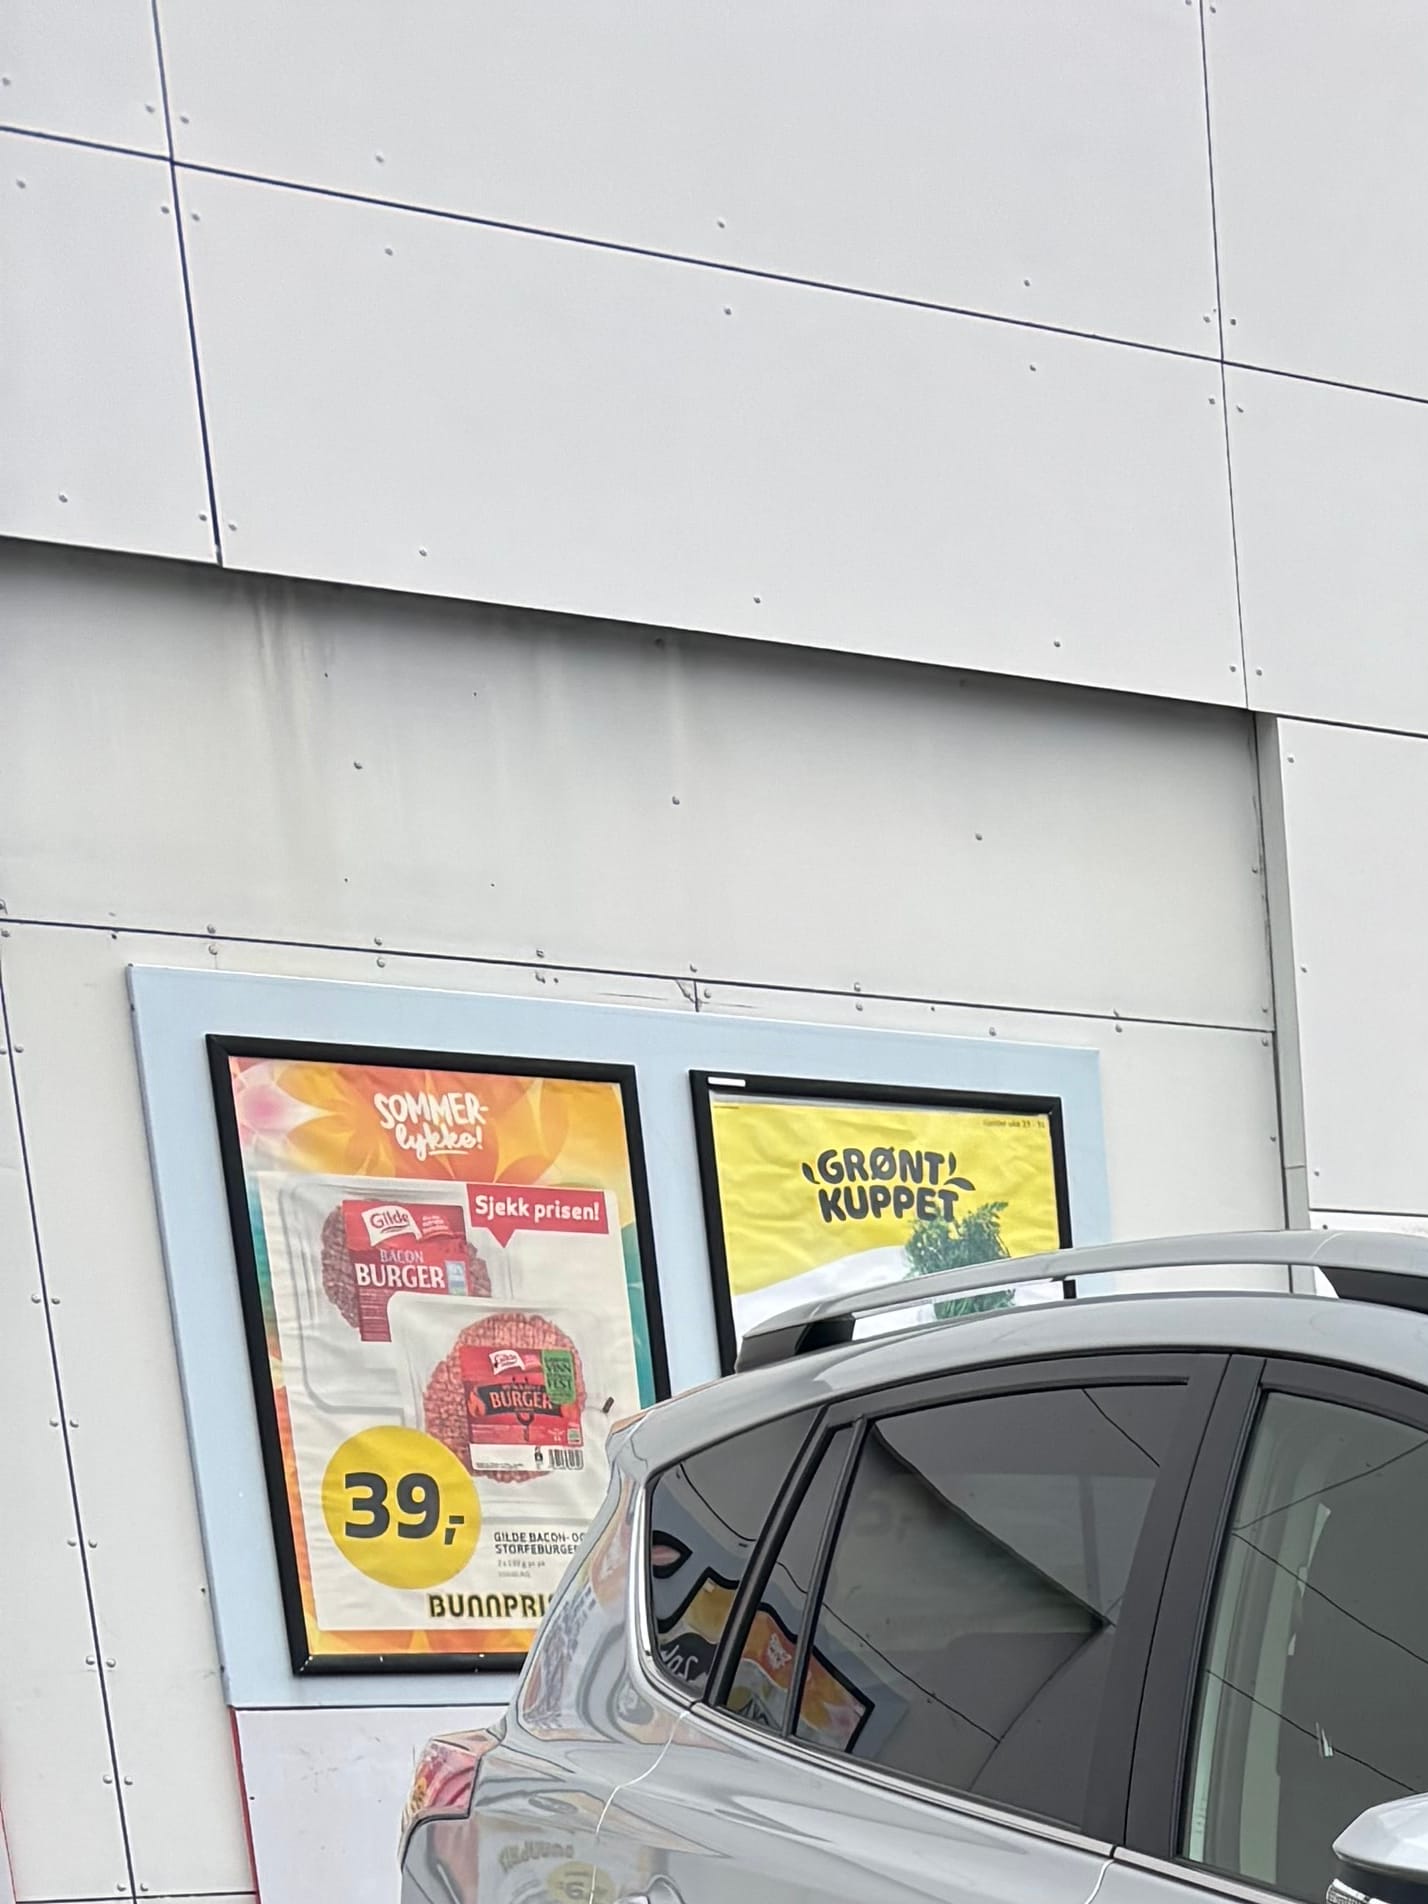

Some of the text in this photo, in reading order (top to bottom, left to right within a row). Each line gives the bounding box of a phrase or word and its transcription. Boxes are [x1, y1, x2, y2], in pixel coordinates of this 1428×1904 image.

[373, 1092, 488, 1129] SOMMER-
[818, 1146, 946, 1184] GRØNT
[475, 1195, 600, 1223] Sjekk prisen!
[818, 1185, 959, 1223] KUPPET
[371, 1209, 410, 1230] Gilde
[380, 1249, 424, 1264] BACON
[354, 1263, 446, 1289] BURGER
[489, 1391, 553, 1410] BURGER
[344, 1471, 465, 1545] 39,-
[494, 1531, 526, 1543] GILDE
[429, 1593, 553, 1617] BUNNPRI
